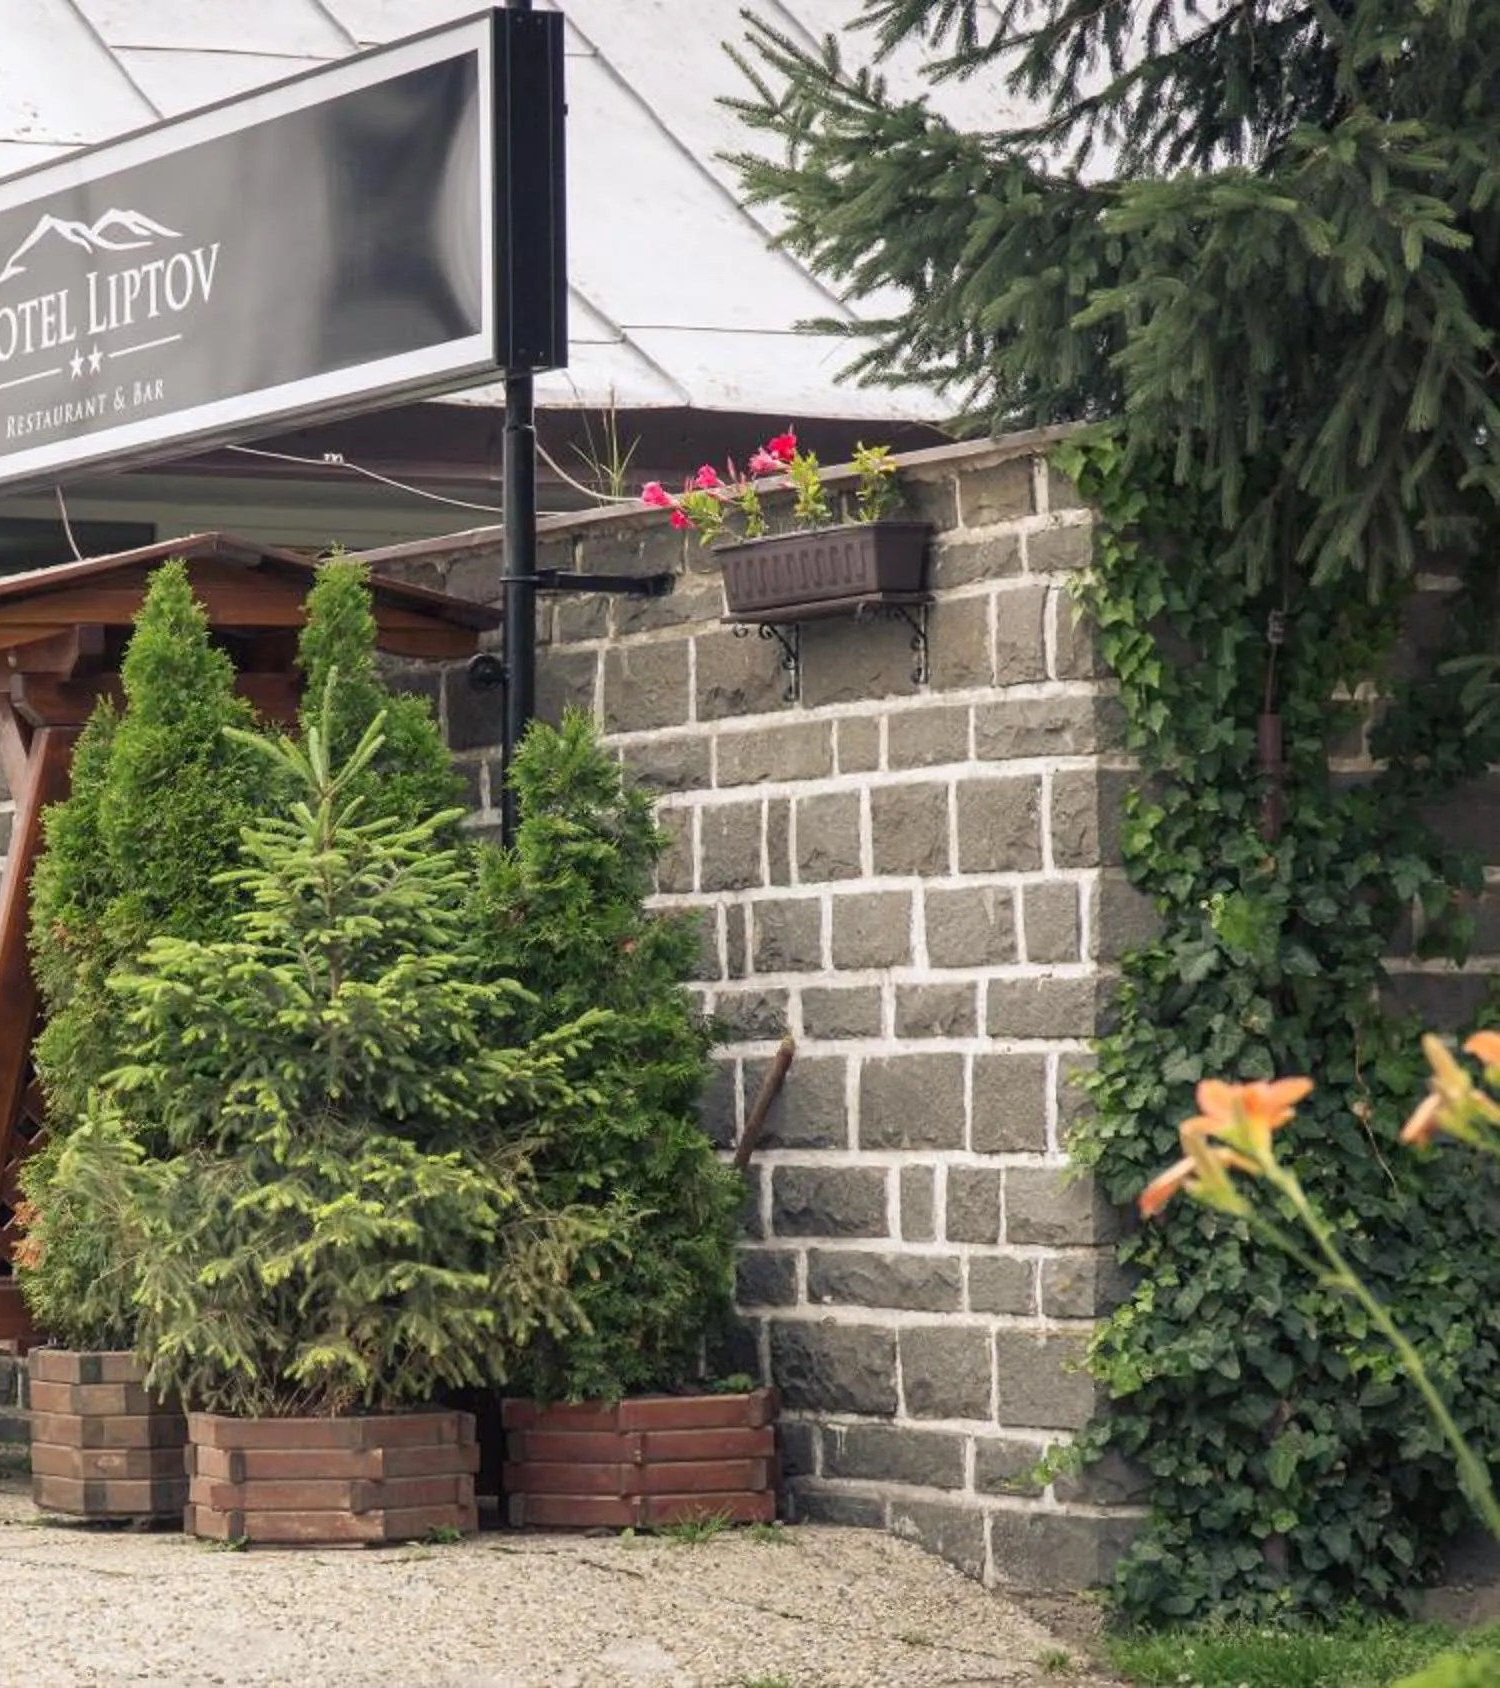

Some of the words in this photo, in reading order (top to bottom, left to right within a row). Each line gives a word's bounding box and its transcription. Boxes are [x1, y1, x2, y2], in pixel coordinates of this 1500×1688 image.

[86, 243, 220, 335] LIPTOV
[6, 393, 108, 439] RESTAURANT
[113, 385, 126, 411] &
[132, 378, 165, 406] BAR
